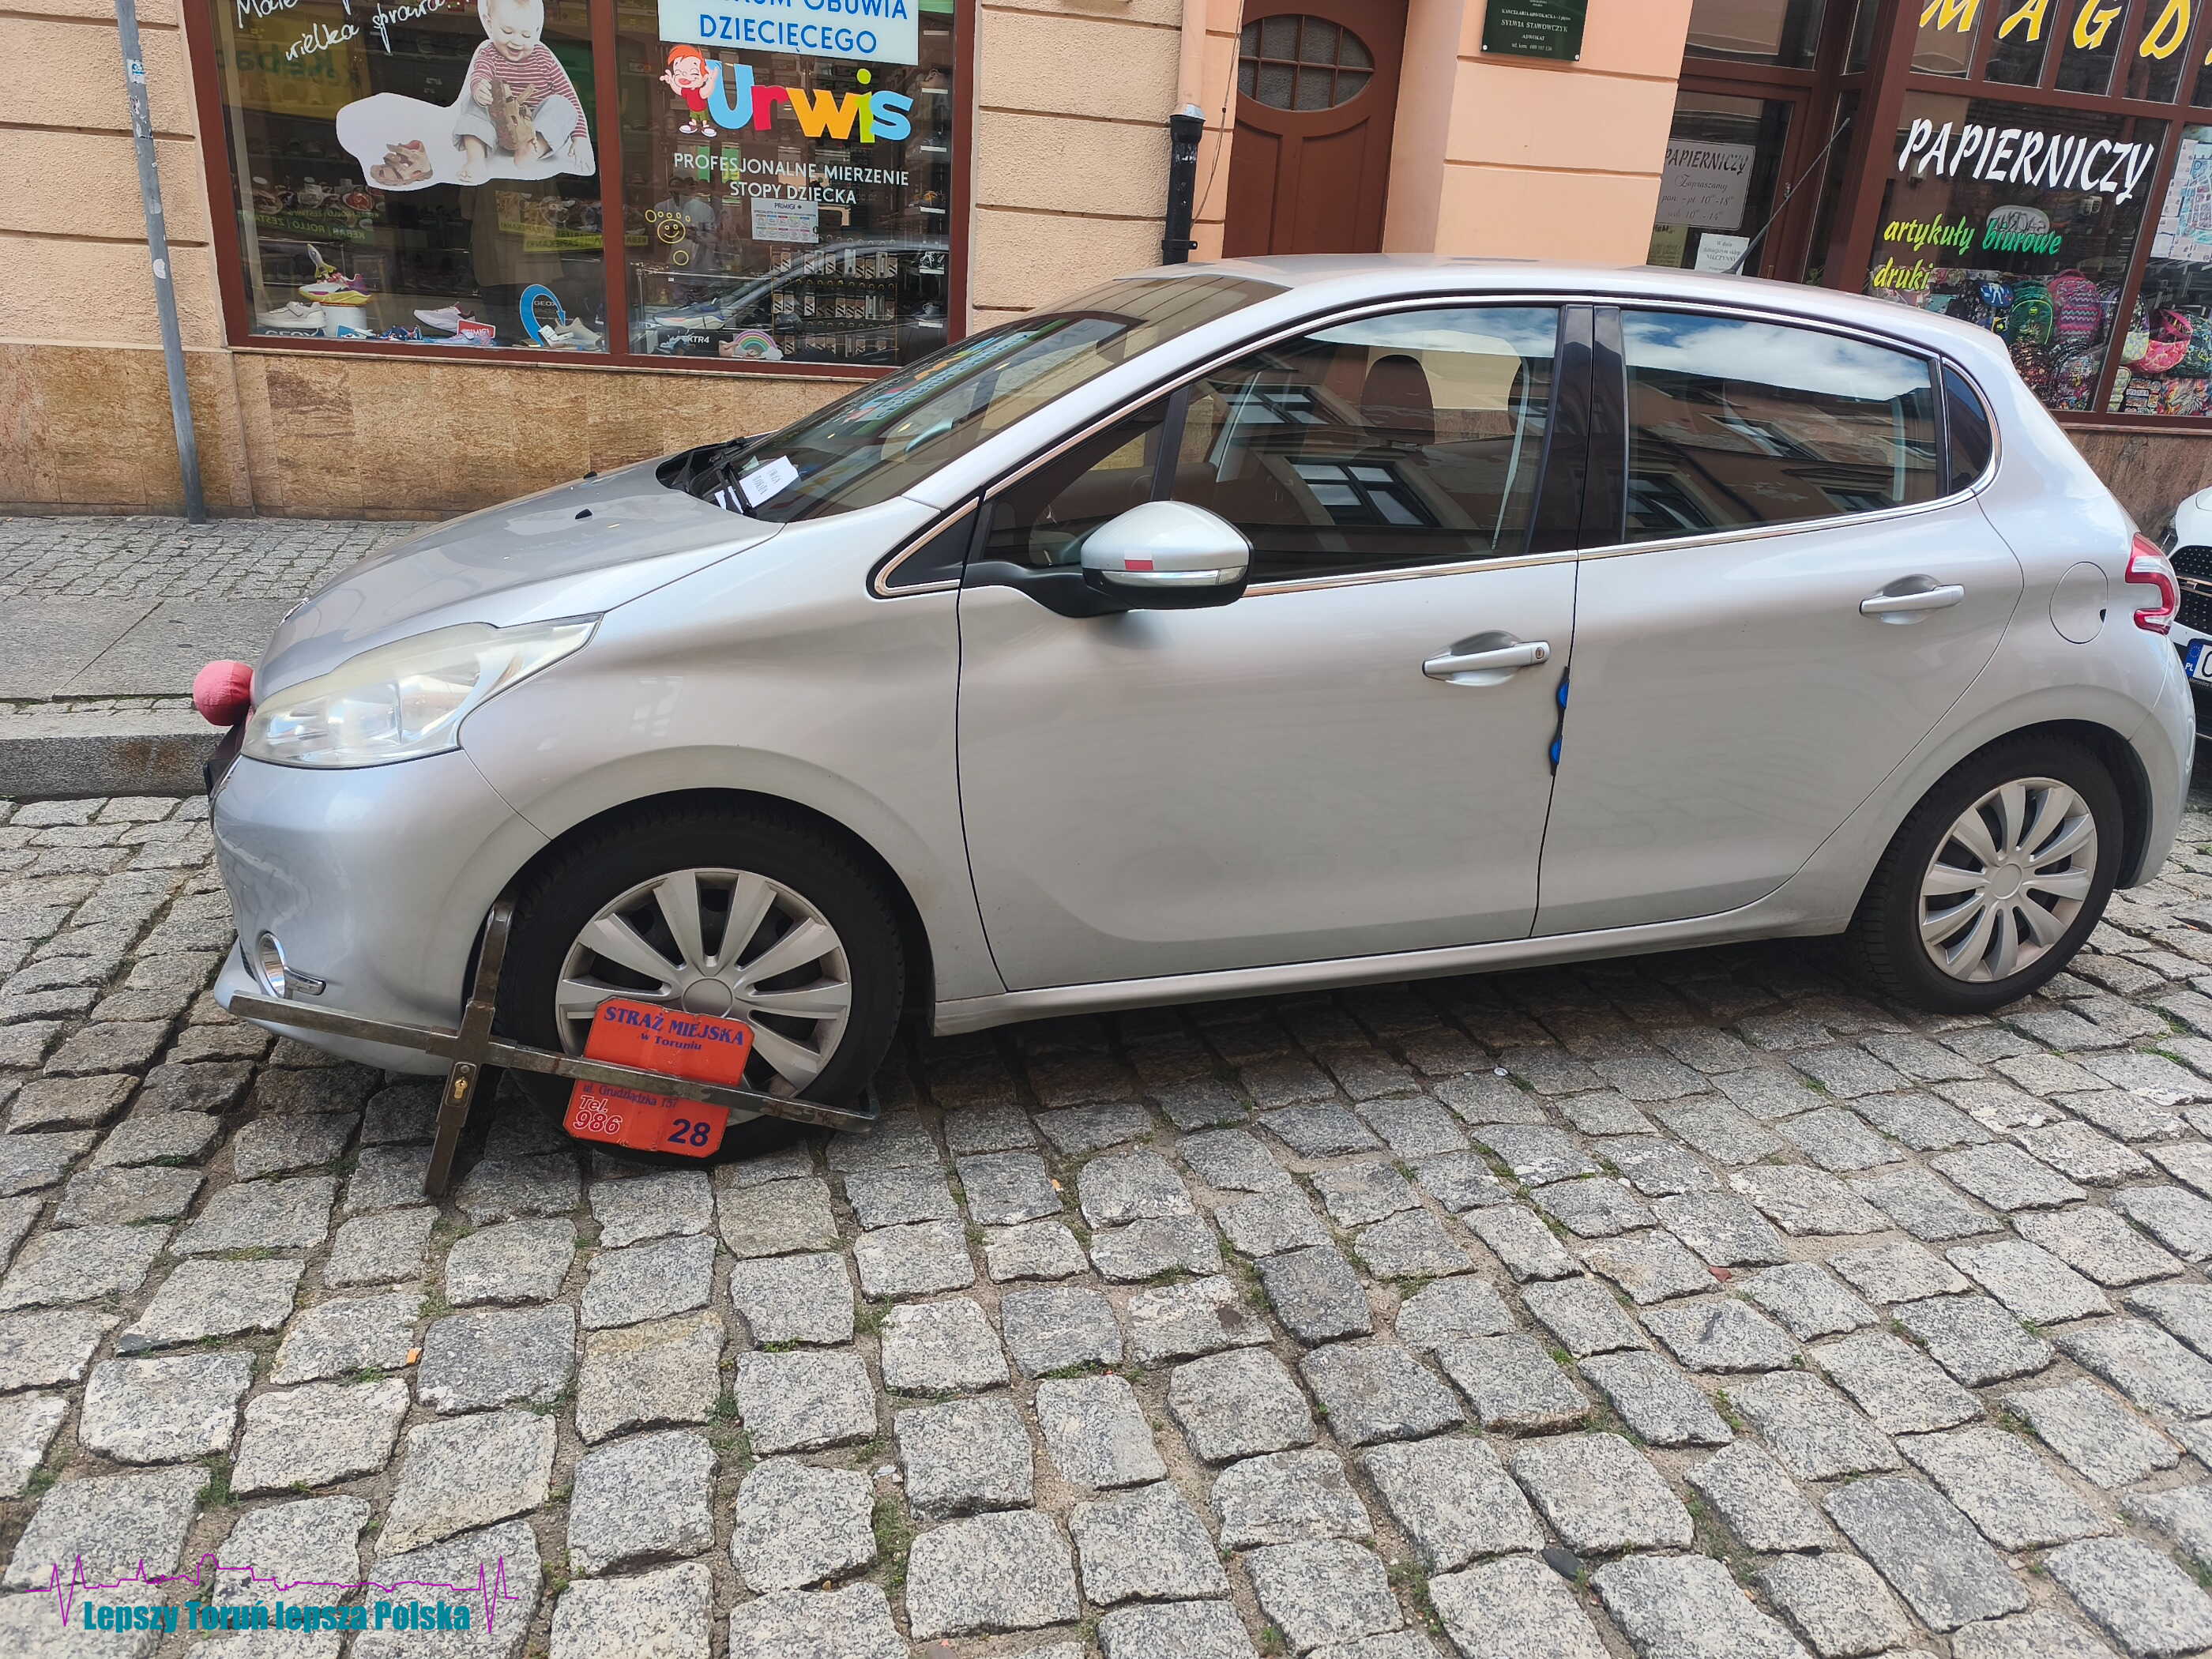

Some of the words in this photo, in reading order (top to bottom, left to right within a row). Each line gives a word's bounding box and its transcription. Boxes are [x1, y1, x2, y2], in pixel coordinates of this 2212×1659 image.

[699, 14, 878, 53] DZIECIĘCEGO
[1501, 19, 1524, 28] SYLWIA
[285, 23, 359, 61] wielka
[705, 59, 914, 143] Urwis
[674, 152, 816, 179] PROFESJONALNE
[824, 164, 909, 186] MIERZENIE
[1898, 118, 2154, 205] PAPIERNICZY
[730, 181, 782, 199] STOPY
[787, 185, 856, 205] DZIECKA
[1883, 213, 1975, 255] artykuły
[1982, 218, 2063, 255] biurowe
[1873, 256, 1934, 291] druki
[2185, 662, 2194, 672] PL
[604, 1006, 664, 1033] STRAŻ
[668, 1020, 744, 1046] MIEJSKA
[655, 1036, 702, 1051] Toruniu
[579, 1095, 608, 1112] Tel.
[573, 1109, 623, 1134] 986
[668, 1118, 711, 1146] 28
